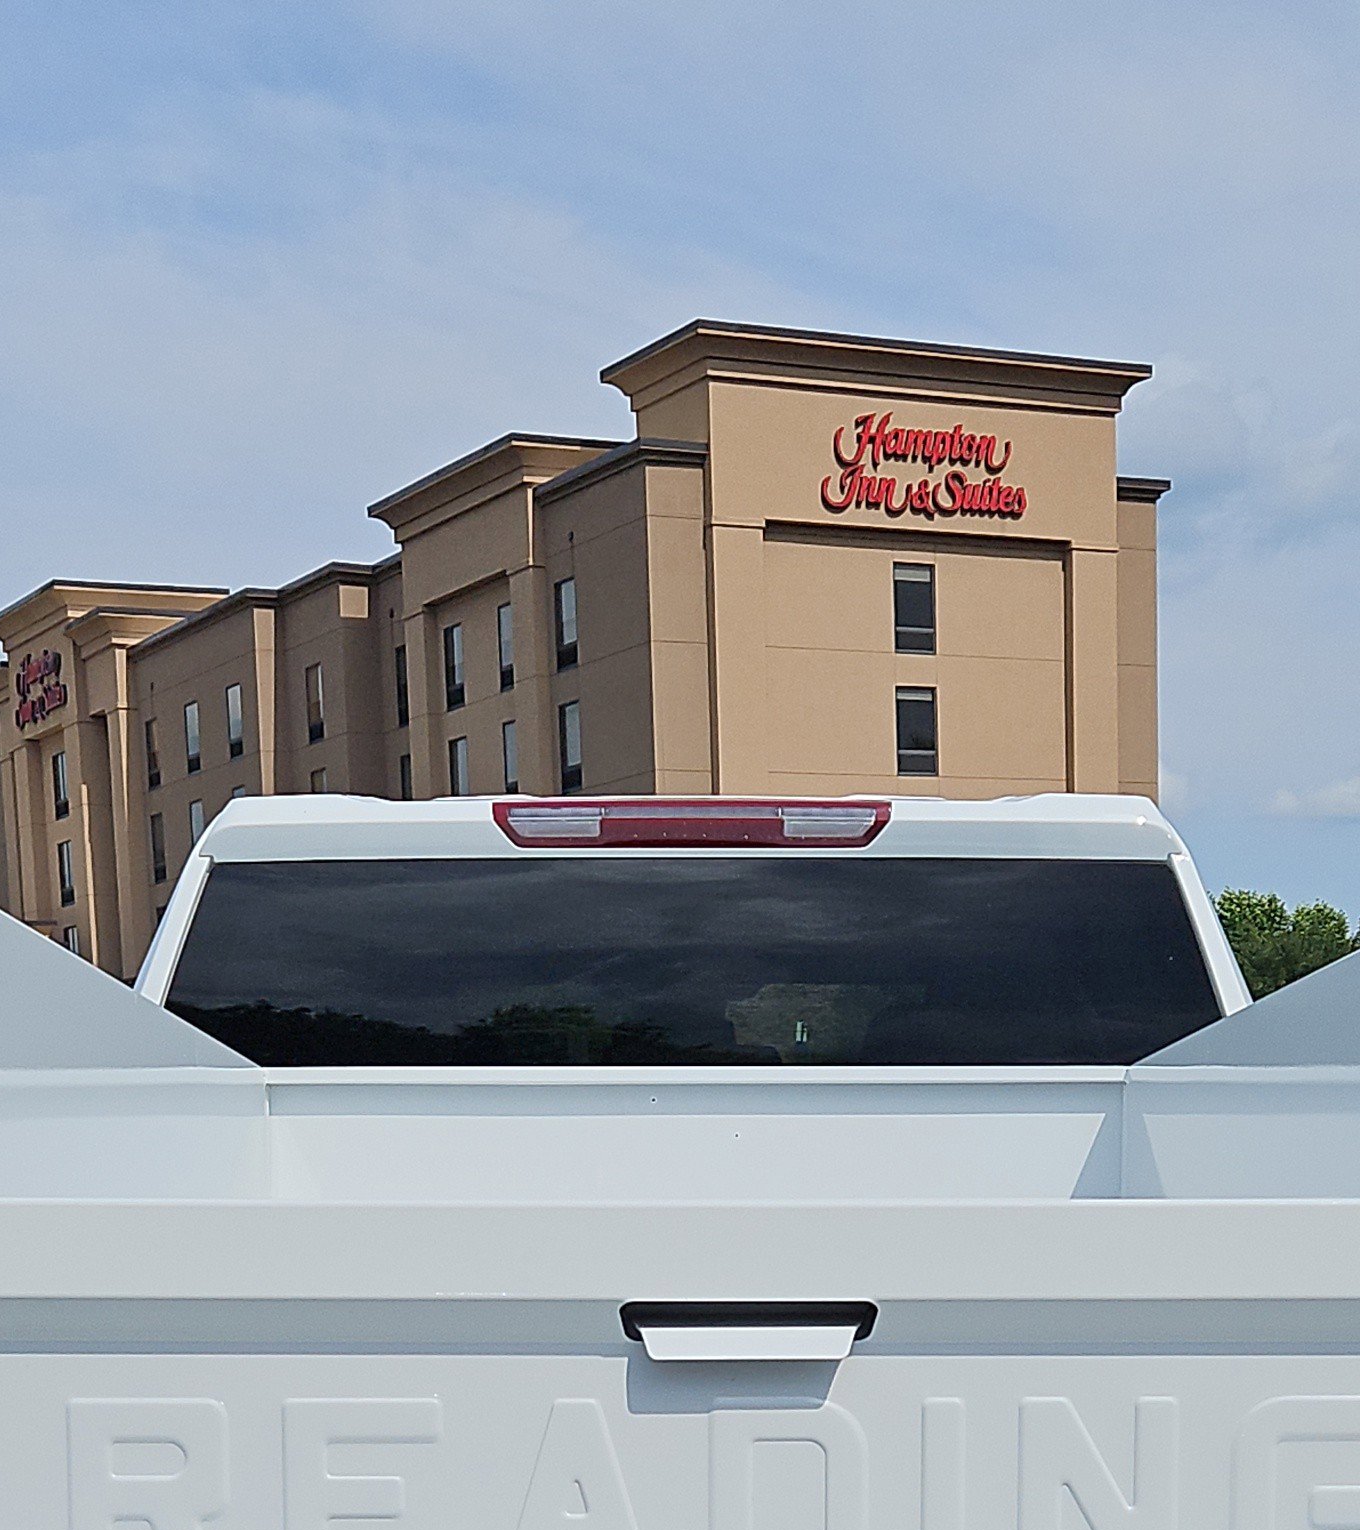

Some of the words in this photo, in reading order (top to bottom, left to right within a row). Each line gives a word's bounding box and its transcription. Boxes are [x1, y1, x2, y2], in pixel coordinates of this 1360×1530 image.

[833, 411, 1012, 475] Hampton
[820, 463, 914, 518] Inn
[909, 478, 938, 521] &
[931, 469, 1028, 521] Suites
